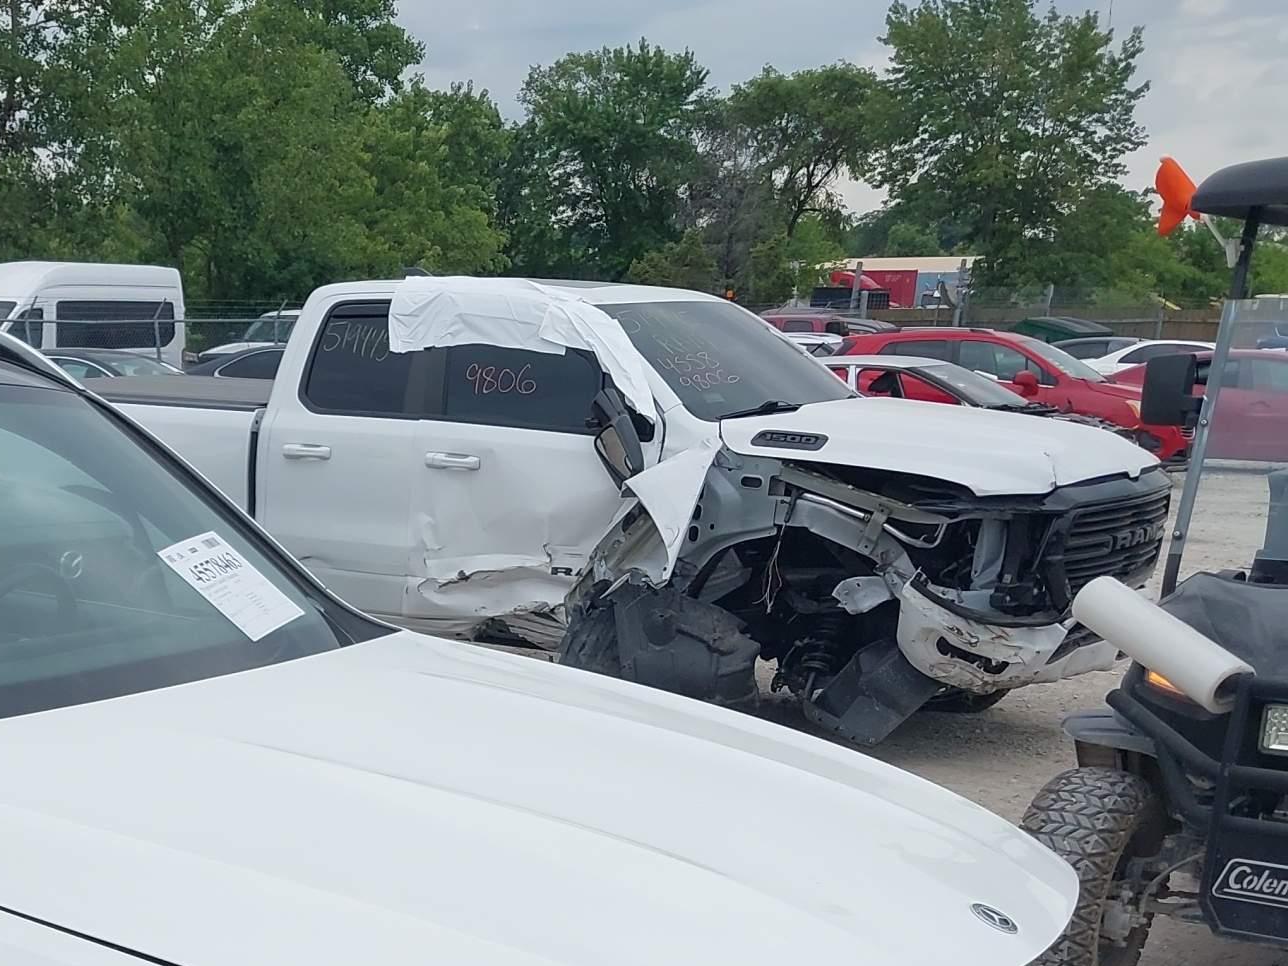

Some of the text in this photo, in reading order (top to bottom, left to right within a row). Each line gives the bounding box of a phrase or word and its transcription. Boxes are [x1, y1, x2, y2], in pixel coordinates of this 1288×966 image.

[657, 352, 720, 374] 4558
[465, 363, 537, 395] 9806
[758, 431, 818, 444] 1500
[1115, 522, 1166, 550] RAM
[188, 552, 243, 584] 45578463
